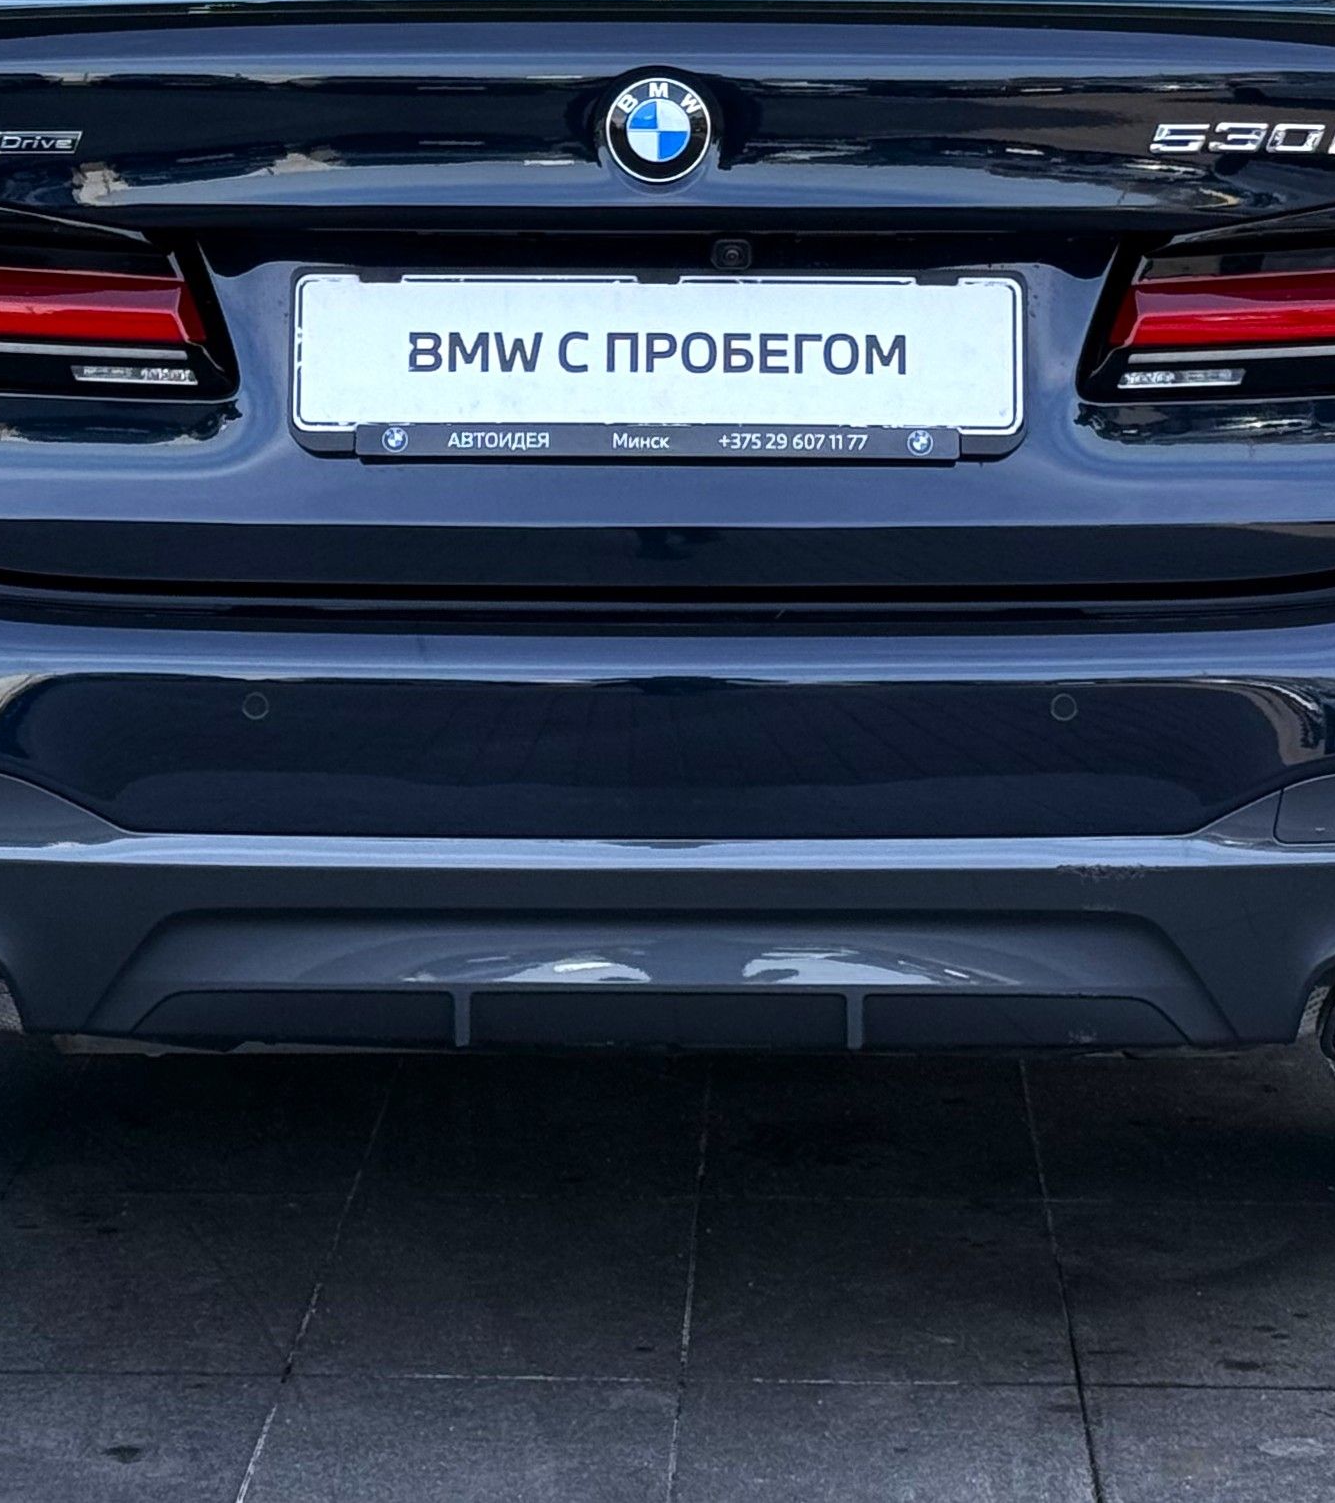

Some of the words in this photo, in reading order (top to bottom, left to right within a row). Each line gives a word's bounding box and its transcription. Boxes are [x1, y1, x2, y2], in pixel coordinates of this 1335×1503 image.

[617, 81, 703, 115] BMW
[408, 331, 543, 373] BMW
[606, 331, 907, 375] ПРОБЕГОМ
[447, 431, 550, 451] АВТОИДЕЯ
[612, 432, 669, 450] Минск
[718, 433, 761, 450] +375
[765, 433, 788, 450] 29
[792, 433, 825, 450] 607
[829, 434, 843, 450] 11
[847, 434, 868, 451] 77
